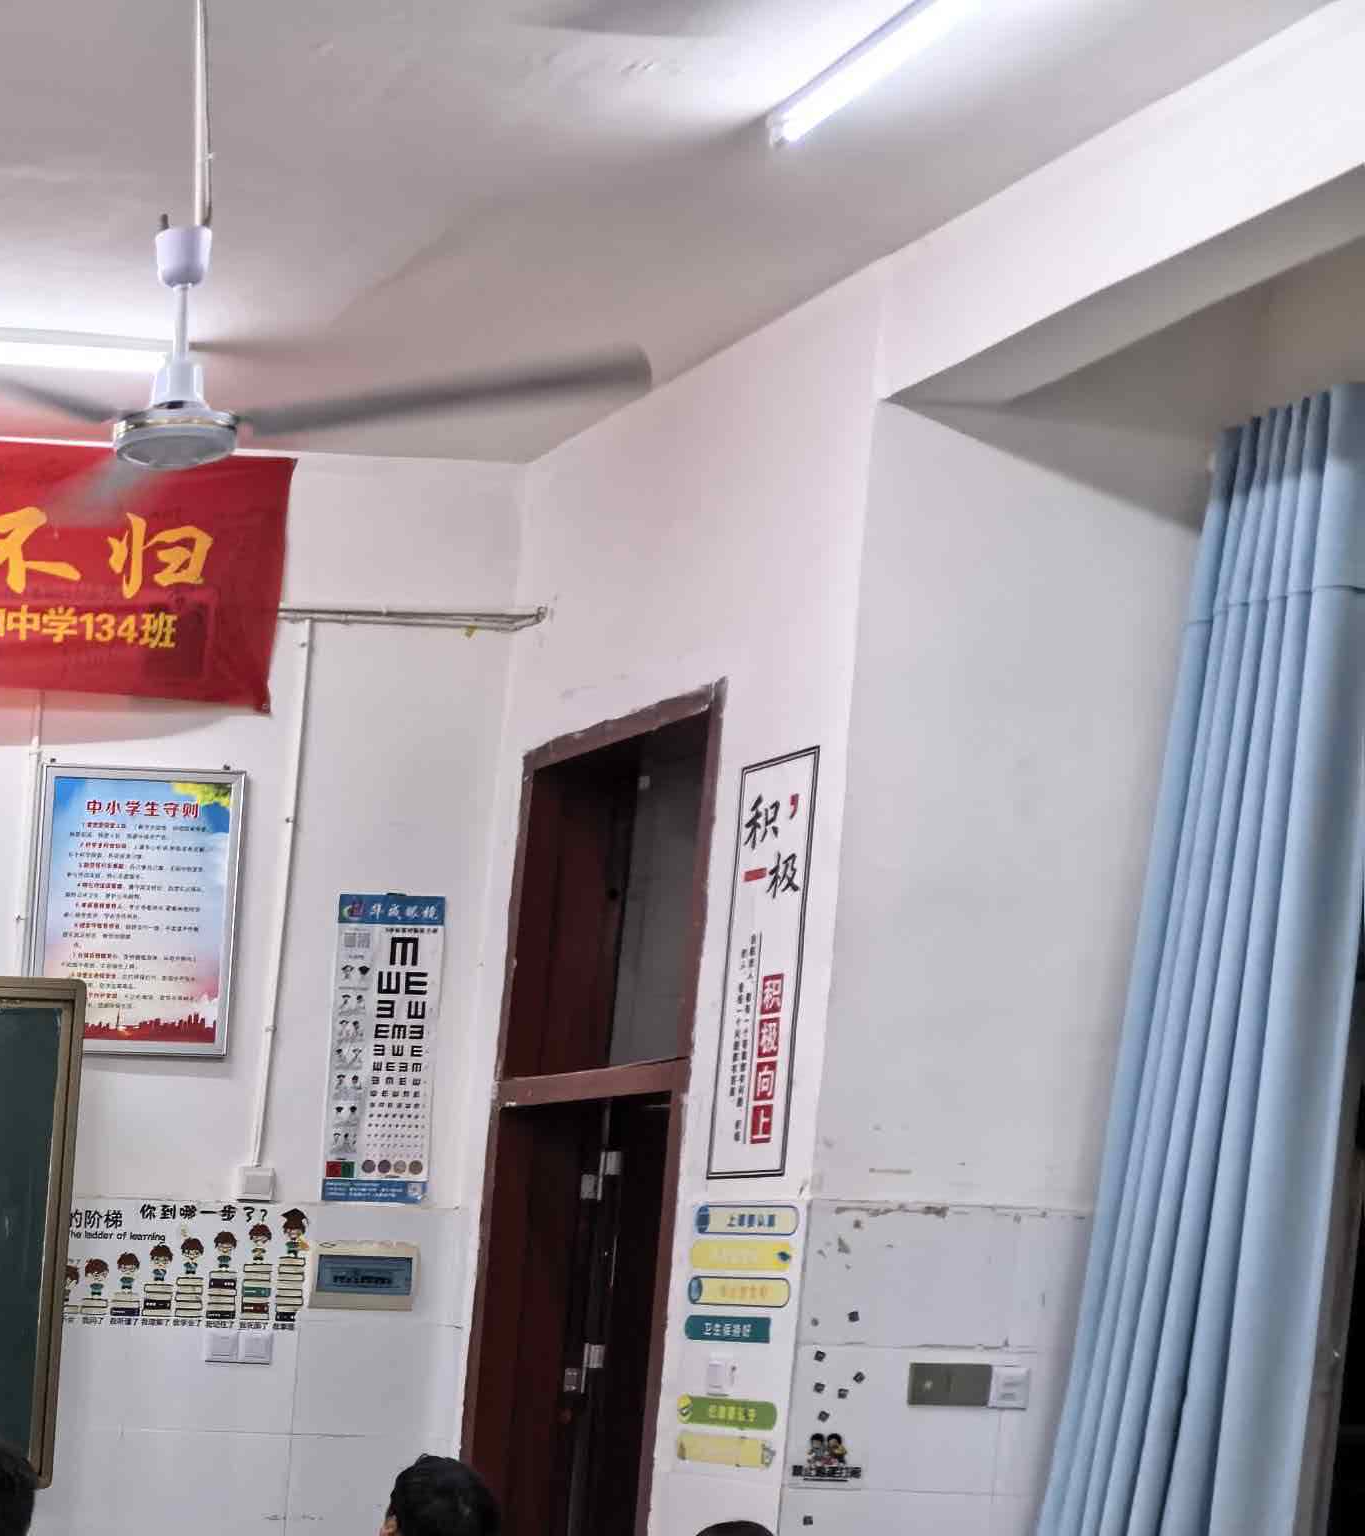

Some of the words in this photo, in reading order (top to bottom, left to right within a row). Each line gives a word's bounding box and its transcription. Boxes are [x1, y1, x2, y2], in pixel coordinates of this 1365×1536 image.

[85, 799, 200, 818] 中小学生守则
[743, 795, 801, 899] 积极
